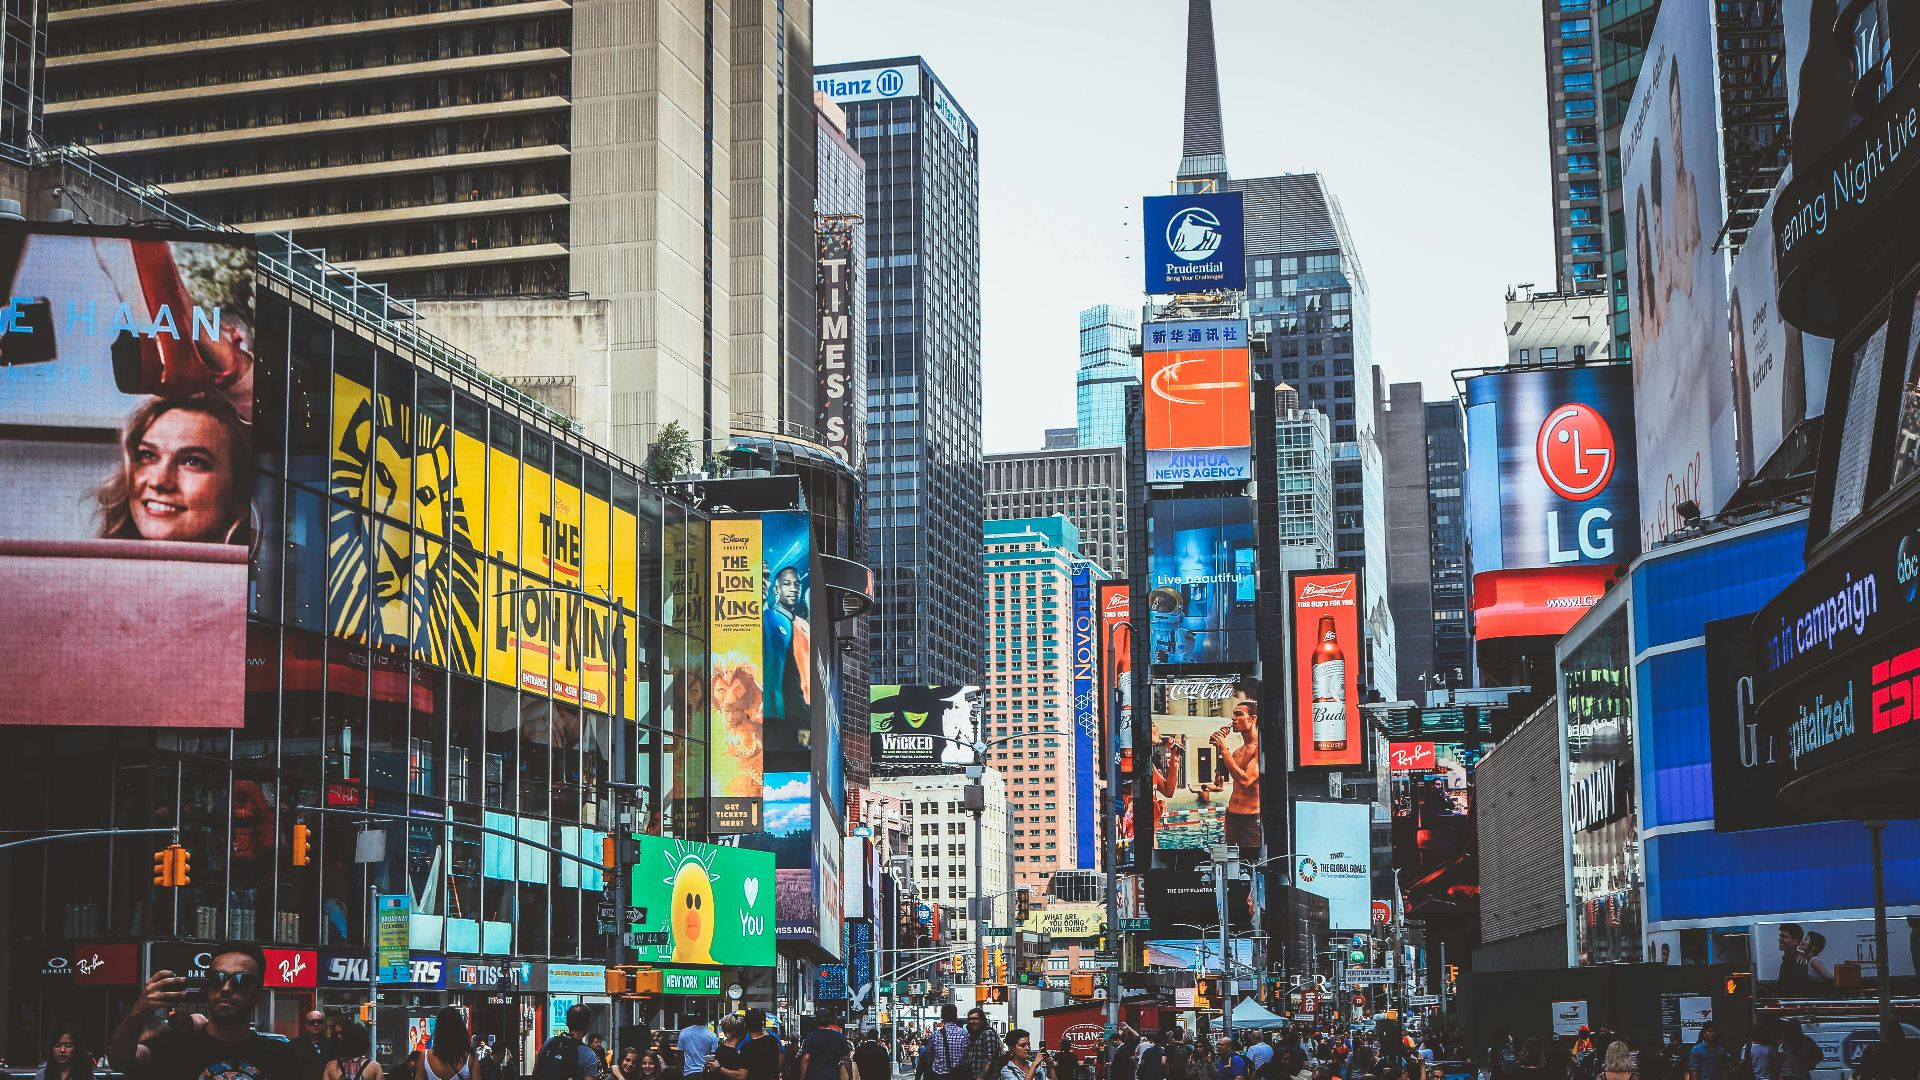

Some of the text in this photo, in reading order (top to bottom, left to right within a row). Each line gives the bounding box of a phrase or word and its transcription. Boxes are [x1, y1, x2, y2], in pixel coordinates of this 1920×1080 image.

[816, 79, 871, 97] llianz
[1833, 138, 1885, 210] Night
[1887, 107, 1917, 162] Live
[1166, 262, 1224, 275] Prudential
[65, 299, 221, 342] HAAN
[822, 258, 847, 398] TIMES
[1152, 327, 1238, 344] 新华通讯社
[1752, 353, 1773, 392] future
[1169, 453, 1230, 468] XINHUA
[1155, 466, 1245, 479] NEWS AGENCY
[539, 512, 580, 567] THE
[719, 533, 750, 544] Disney
[1547, 508, 1615, 563] LG
[722, 555, 748, 569] THE
[1897, 553, 1919, 584] abc
[717, 571, 754, 594] LION
[1157, 572, 1243, 585] Live beautiful
[1303, 583, 1349, 596] Budweiser
[714, 595, 760, 622] KING
[1547, 596, 1602, 608] www.LG.c
[496, 551, 628, 673] LION KING
[1782, 616, 1794, 665] in
[1796, 572, 1877, 654] campaign
[522, 674, 549, 689] ENTRANCE
[554, 681, 563, 694] ON
[582, 688, 599, 704] STREET
[881, 733, 933, 750] WICKED
[1391, 744, 1432, 766] Ray-Ban
[1569, 760, 1616, 834] OLD NAVY
[720, 819, 744, 827] HERE!
[1319, 864, 1367, 873] THE GLOBAL GOALS
[381, 915, 408, 923] BROADWAY
[739, 907, 764, 937] YOU
[1120, 919, 1127, 928] W
[1130, 919, 1141, 928] 44
[1064, 925, 1088, 933] THERE?
[647, 934, 658, 942] 44
[77, 953, 105, 976] Ray-Ban
[278, 953, 307, 984] Ray-Ban
[187, 970, 206, 978] OAK
[666, 975, 681, 988] NEW
[682, 975, 698, 988] YORK
[1065, 1030, 1105, 1041] STRAN
